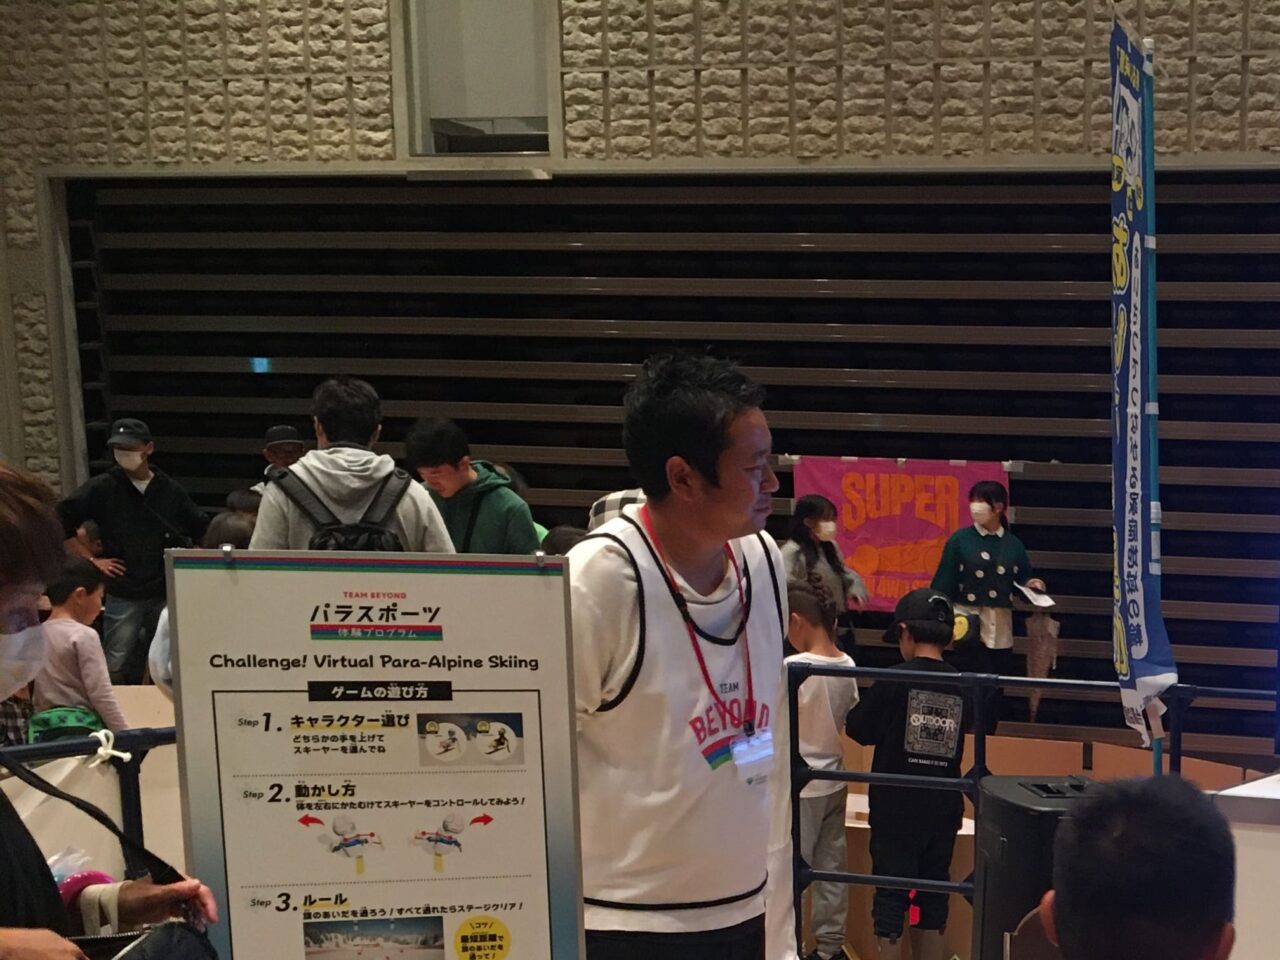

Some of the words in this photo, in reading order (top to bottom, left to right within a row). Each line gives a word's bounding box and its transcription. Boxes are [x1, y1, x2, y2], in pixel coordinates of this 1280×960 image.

[842, 472, 959, 532] SUPER
[343, 591, 368, 599] TEAM
[310, 602, 440, 623] パラスポーツ
[209, 654, 308, 670] Challenge!
[313, 654, 374, 668] Virtual
[380, 655, 483, 671] Para-Alpine
[488, 655, 539, 671] Skiing
[331, 685, 428, 698] ゲームの遊び方
[719, 682, 740, 694] TEAM
[237, 718, 259, 728] Step
[290, 713, 410, 728] キャラクター選び
[243, 790, 264, 800] Step
[294, 783, 356, 798] 動かし方
[250, 898, 272, 908] Step
[303, 893, 348, 906] ルール
